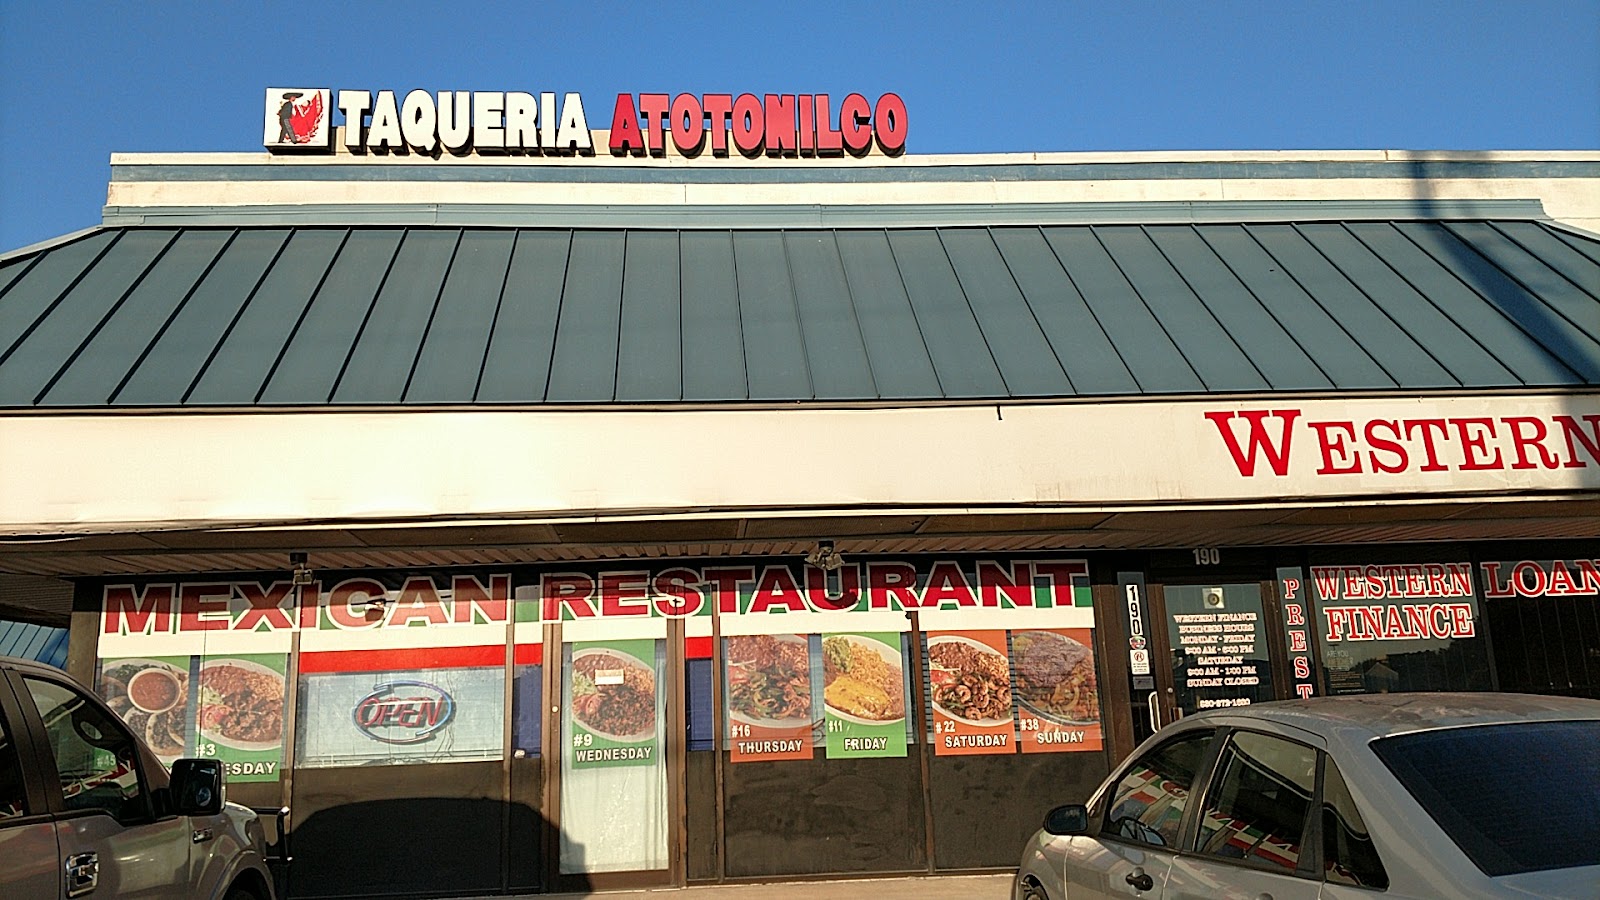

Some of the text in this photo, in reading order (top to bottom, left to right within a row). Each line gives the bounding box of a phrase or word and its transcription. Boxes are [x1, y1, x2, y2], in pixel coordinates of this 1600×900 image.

[338, 88, 909, 156] TAQUERIA ATOTONILCO
[1204, 409, 1600, 477] WESTERN
[1192, 548, 1220, 565] 190
[1311, 562, 1474, 600] WESTERN
[1480, 559, 1600, 598] LOAN
[102, 558, 1090, 637] MEXICAN RESTAURANT
[1173, 613, 1258, 623] WESTERN FINANCE
[1322, 603, 1476, 641] FINANCE
[1179, 624, 1255, 634] BUSINESS HOURS
[1180, 635, 1219, 644] MONDAY
[1223, 634, 1256, 643] FRIDAY
[1202, 646, 1217, 654] AM
[1239, 645, 1254, 653] PM
[1198, 656, 1244, 665] SATURDAY
[1205, 667, 1220, 676] AM
[1225, 667, 1241, 675] 1:00
[1242, 666, 1257, 675] PM
[1187, 677, 1259, 687] SUNDAY CLOSED
[356, 696, 443, 728] OPEN
[731, 724, 751, 738] #16
[828, 720, 844, 733] #11
[1020, 719, 1040, 731] #38
[573, 733, 593, 747] #9
[844, 737, 888, 751] FRIDAY
[945, 734, 1008, 748] SATURDAY
[1037, 731, 1085, 745] SUNDAY
[195, 743, 217, 757] #3
[738, 740, 803, 754] THURSDAY
[575, 747, 652, 762] WEDNESDAY
[225, 761, 277, 776] ESDAY
